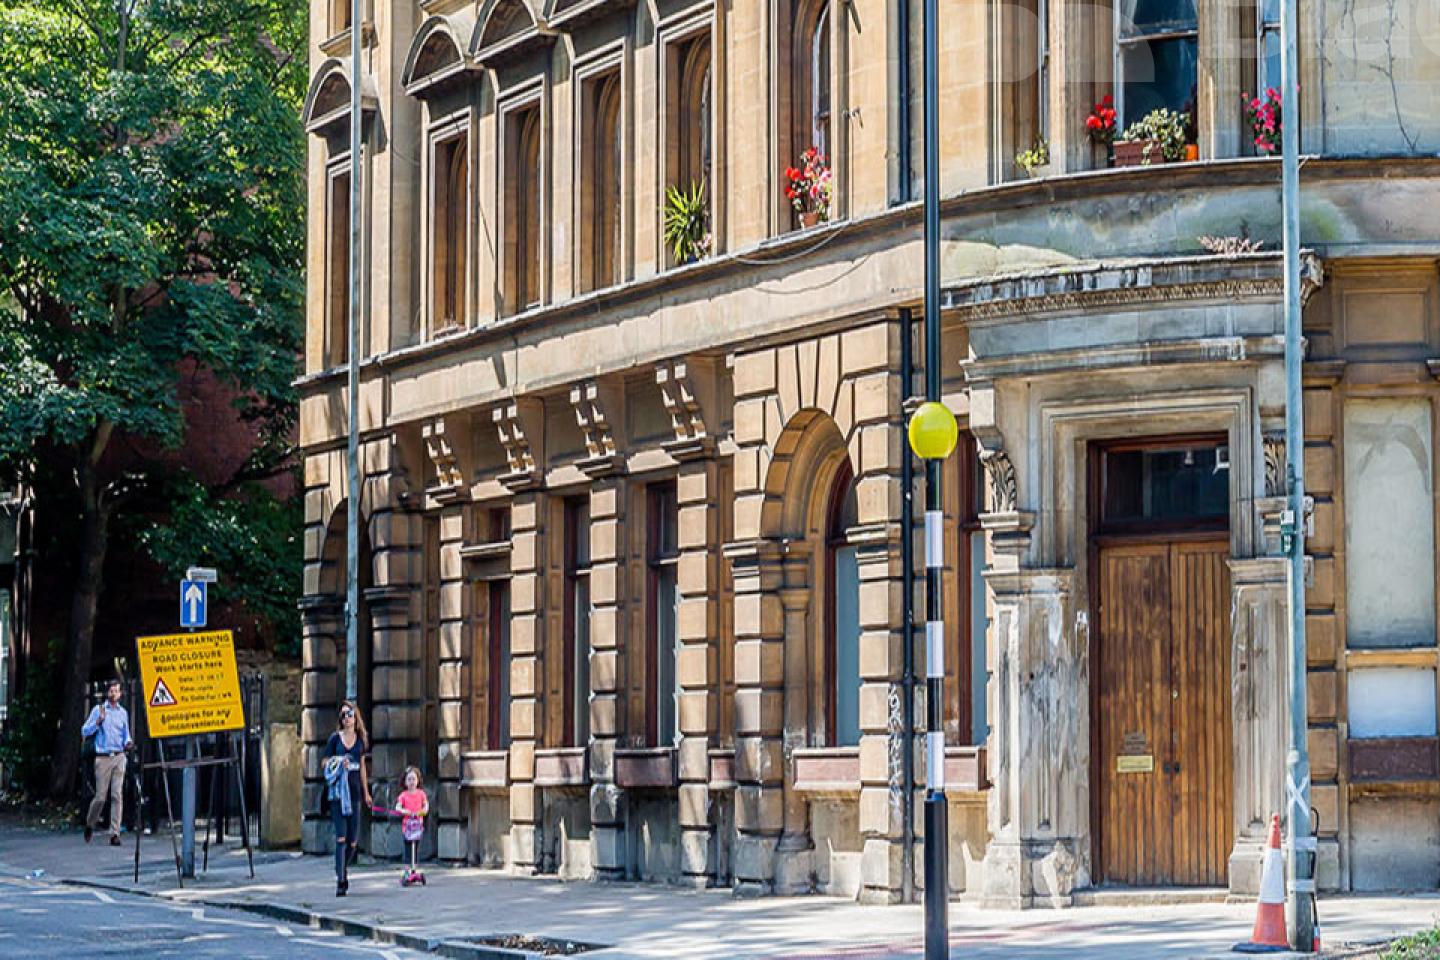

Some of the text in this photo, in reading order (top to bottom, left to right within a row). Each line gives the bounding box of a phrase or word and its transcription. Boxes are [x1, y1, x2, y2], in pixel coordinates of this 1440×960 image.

[141, 634, 229, 650] ADVANCE WARNING
[153, 650, 222, 663] ROAD CLOSURE
[155, 664, 176, 672] Work
